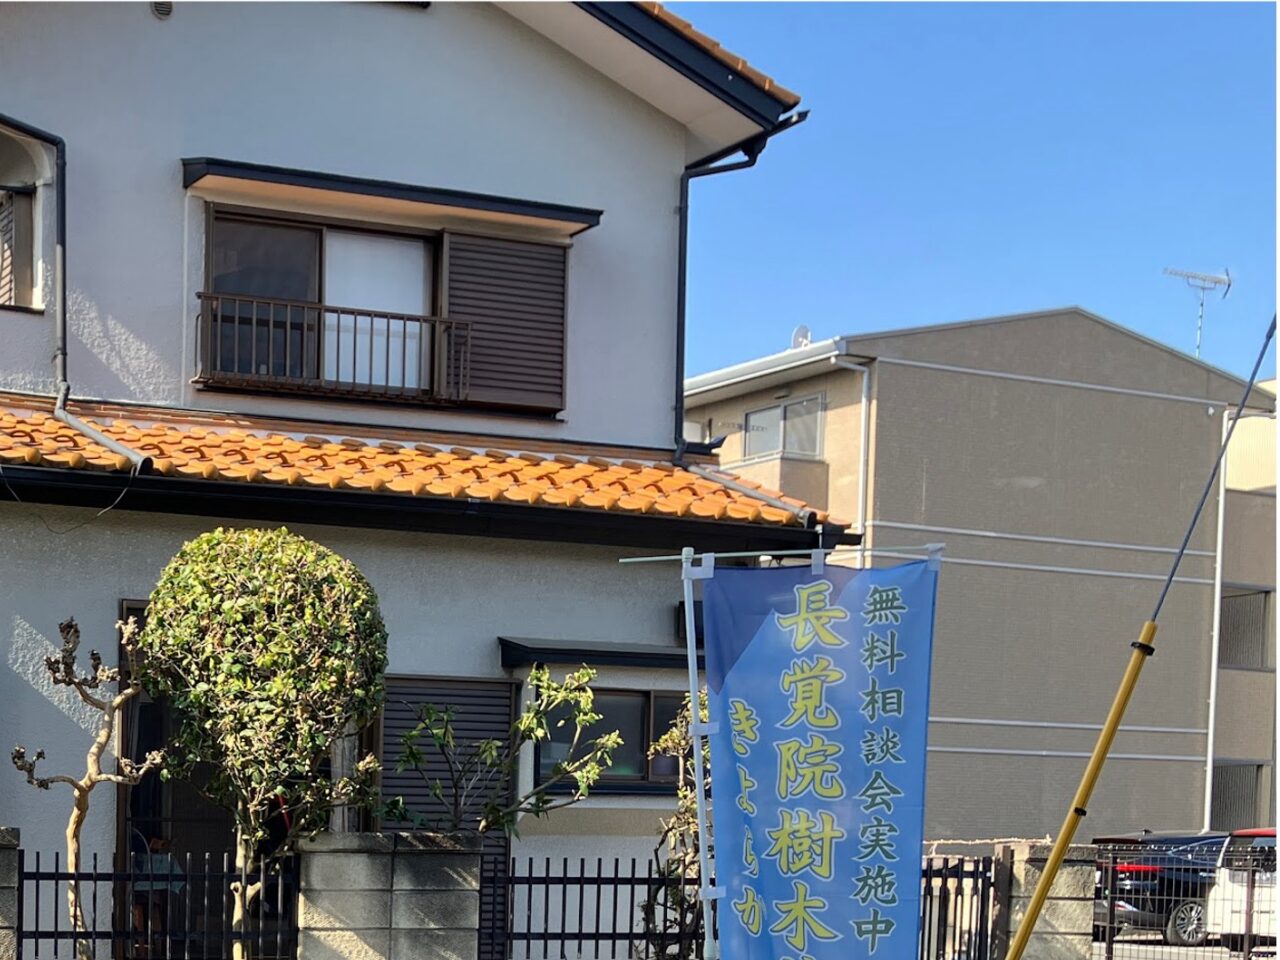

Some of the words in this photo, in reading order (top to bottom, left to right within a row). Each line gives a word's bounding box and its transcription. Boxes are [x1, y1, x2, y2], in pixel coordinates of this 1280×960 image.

[851, 585, 907, 954] 無料相談会実施中
